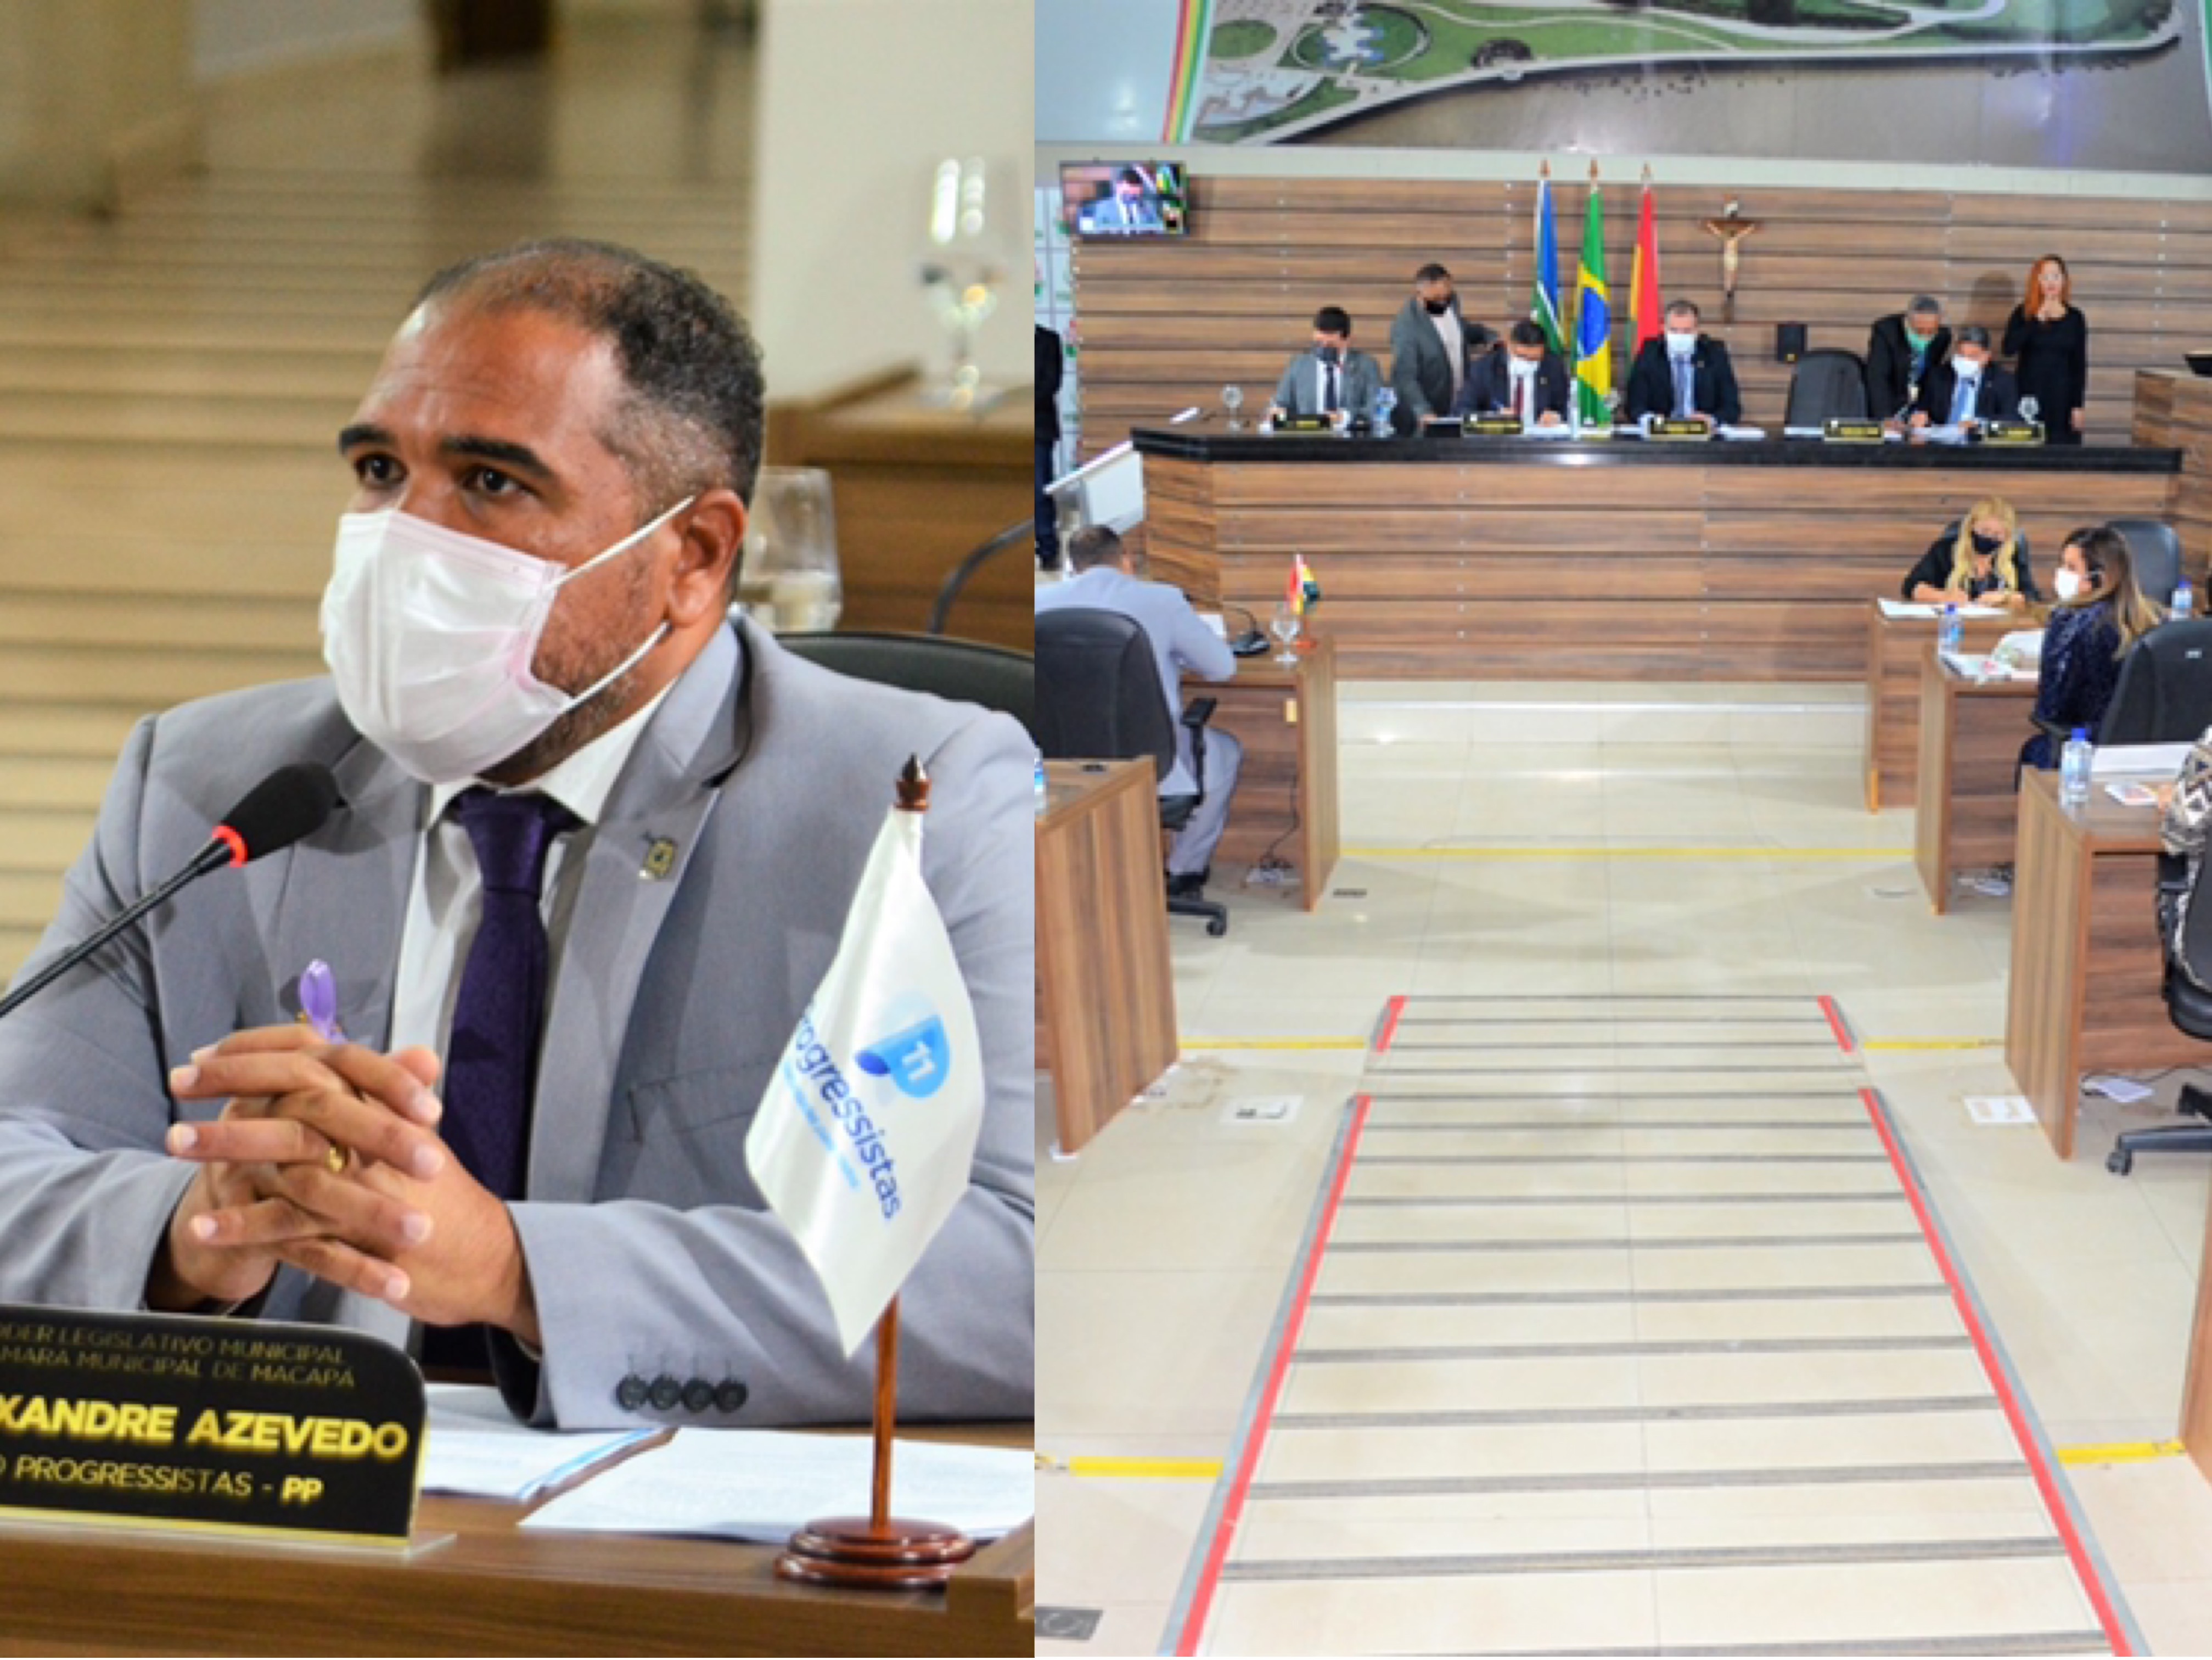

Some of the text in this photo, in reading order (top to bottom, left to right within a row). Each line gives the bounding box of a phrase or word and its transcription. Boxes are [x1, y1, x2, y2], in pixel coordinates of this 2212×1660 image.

[58, 1327, 213, 1355] LEGISLATIVO
[220, 1339, 343, 1365] MUNICIPAL
[76, 1350, 201, 1377] MUNICIPAL
[212, 1360, 245, 1380] DE
[186, 1409, 408, 1458] AZEVEDO
[15, 1455, 252, 1497] PROGRESSISTAS
[280, 1474, 324, 1503] PP
